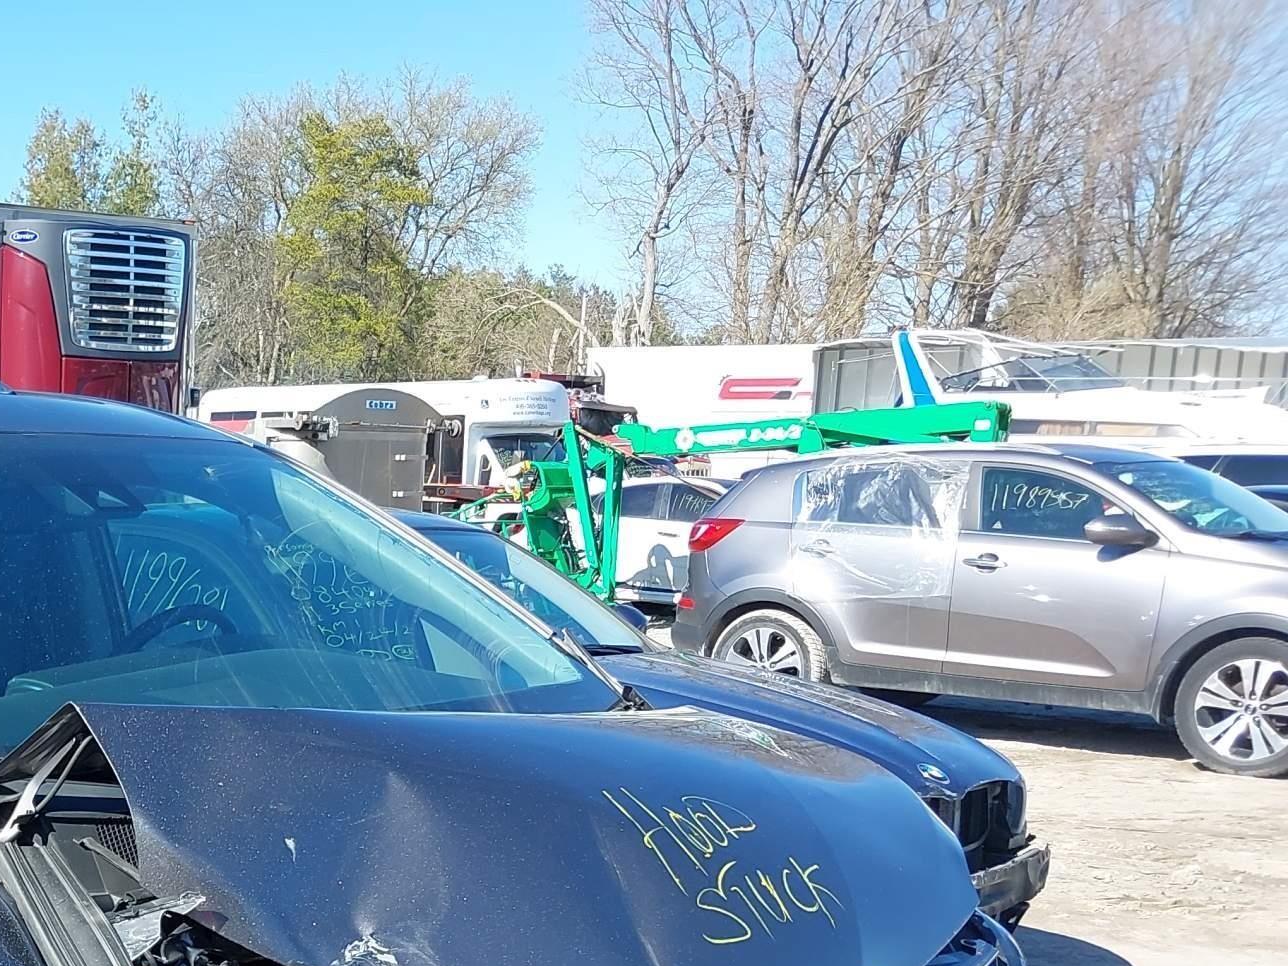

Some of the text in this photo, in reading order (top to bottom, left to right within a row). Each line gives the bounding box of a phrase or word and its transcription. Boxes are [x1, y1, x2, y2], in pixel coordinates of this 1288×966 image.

[368, 400, 394, 409] Cobra
[601, 787, 757, 898] HOOD
[696, 856, 848, 944] STUCK
